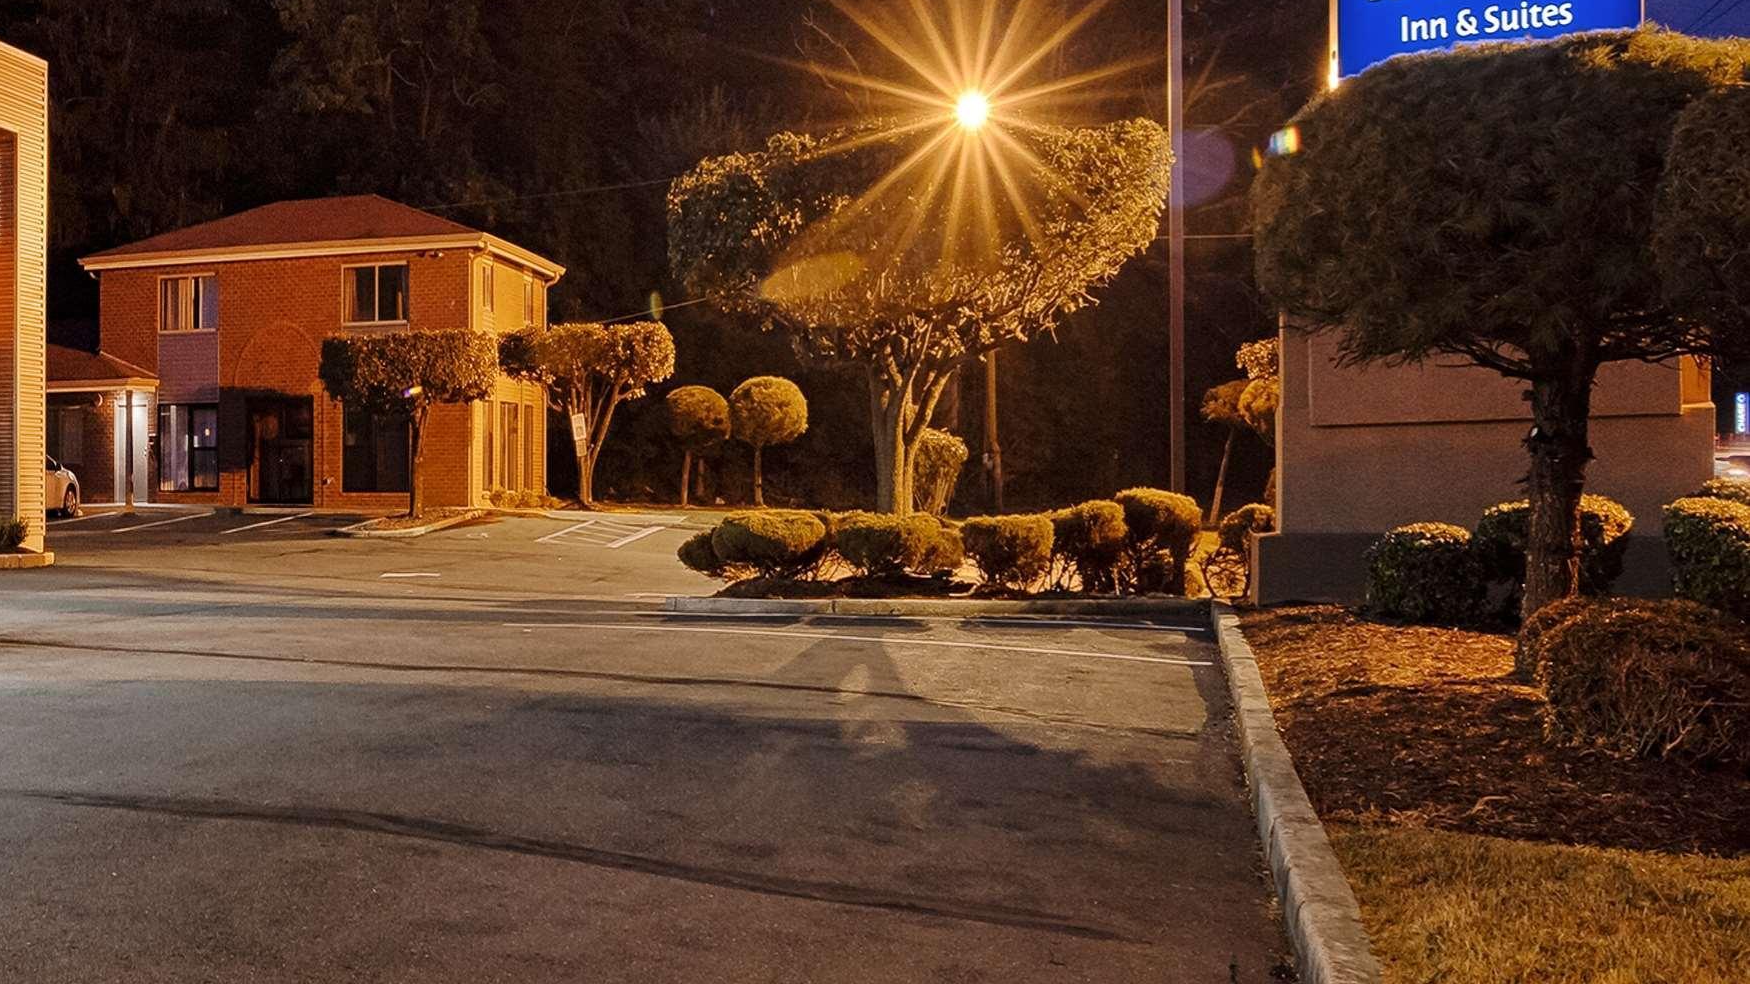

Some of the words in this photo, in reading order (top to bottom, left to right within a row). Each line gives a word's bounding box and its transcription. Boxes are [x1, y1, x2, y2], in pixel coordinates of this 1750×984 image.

[1401, 16, 1447, 42] Inn
[1456, 9, 1478, 34] &
[1485, 1, 1572, 31] Suites
